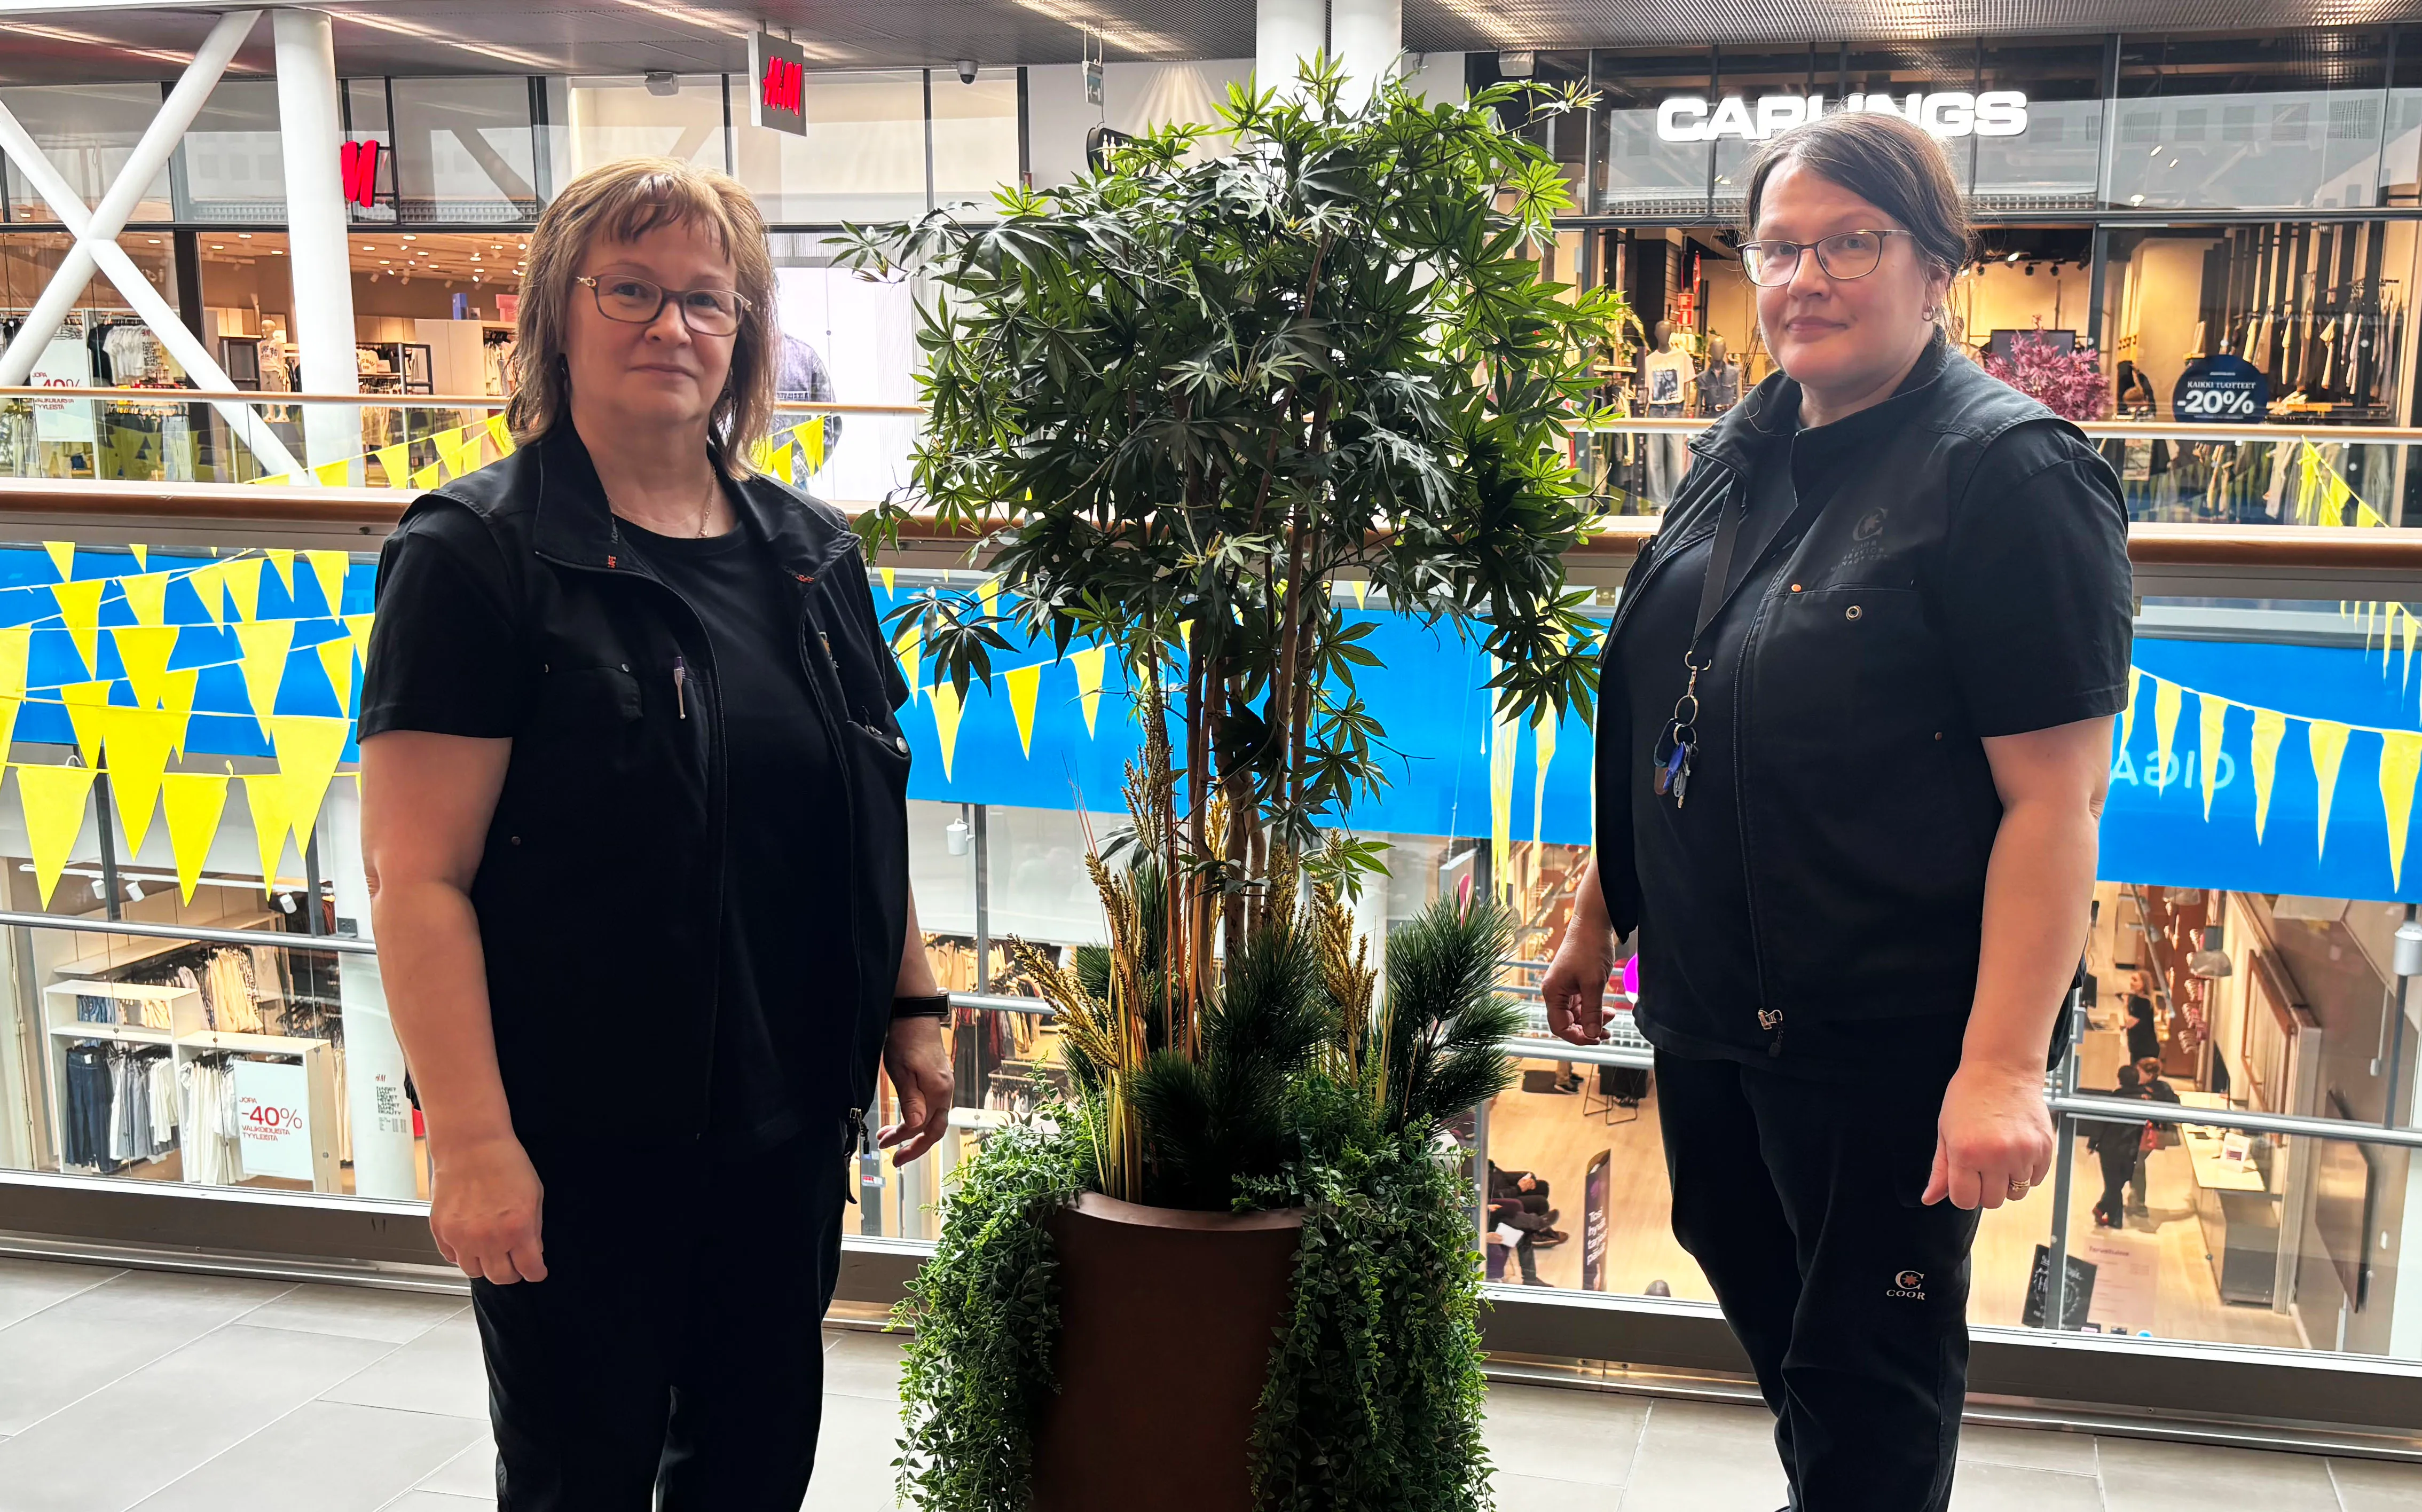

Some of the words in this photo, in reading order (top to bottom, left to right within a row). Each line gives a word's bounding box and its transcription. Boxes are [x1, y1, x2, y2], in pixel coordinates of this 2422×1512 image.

[2177, 390, 2254, 414] -20%
[241, 1106, 302, 1129] -40%
[1886, 1289, 1925, 1300] COOR
